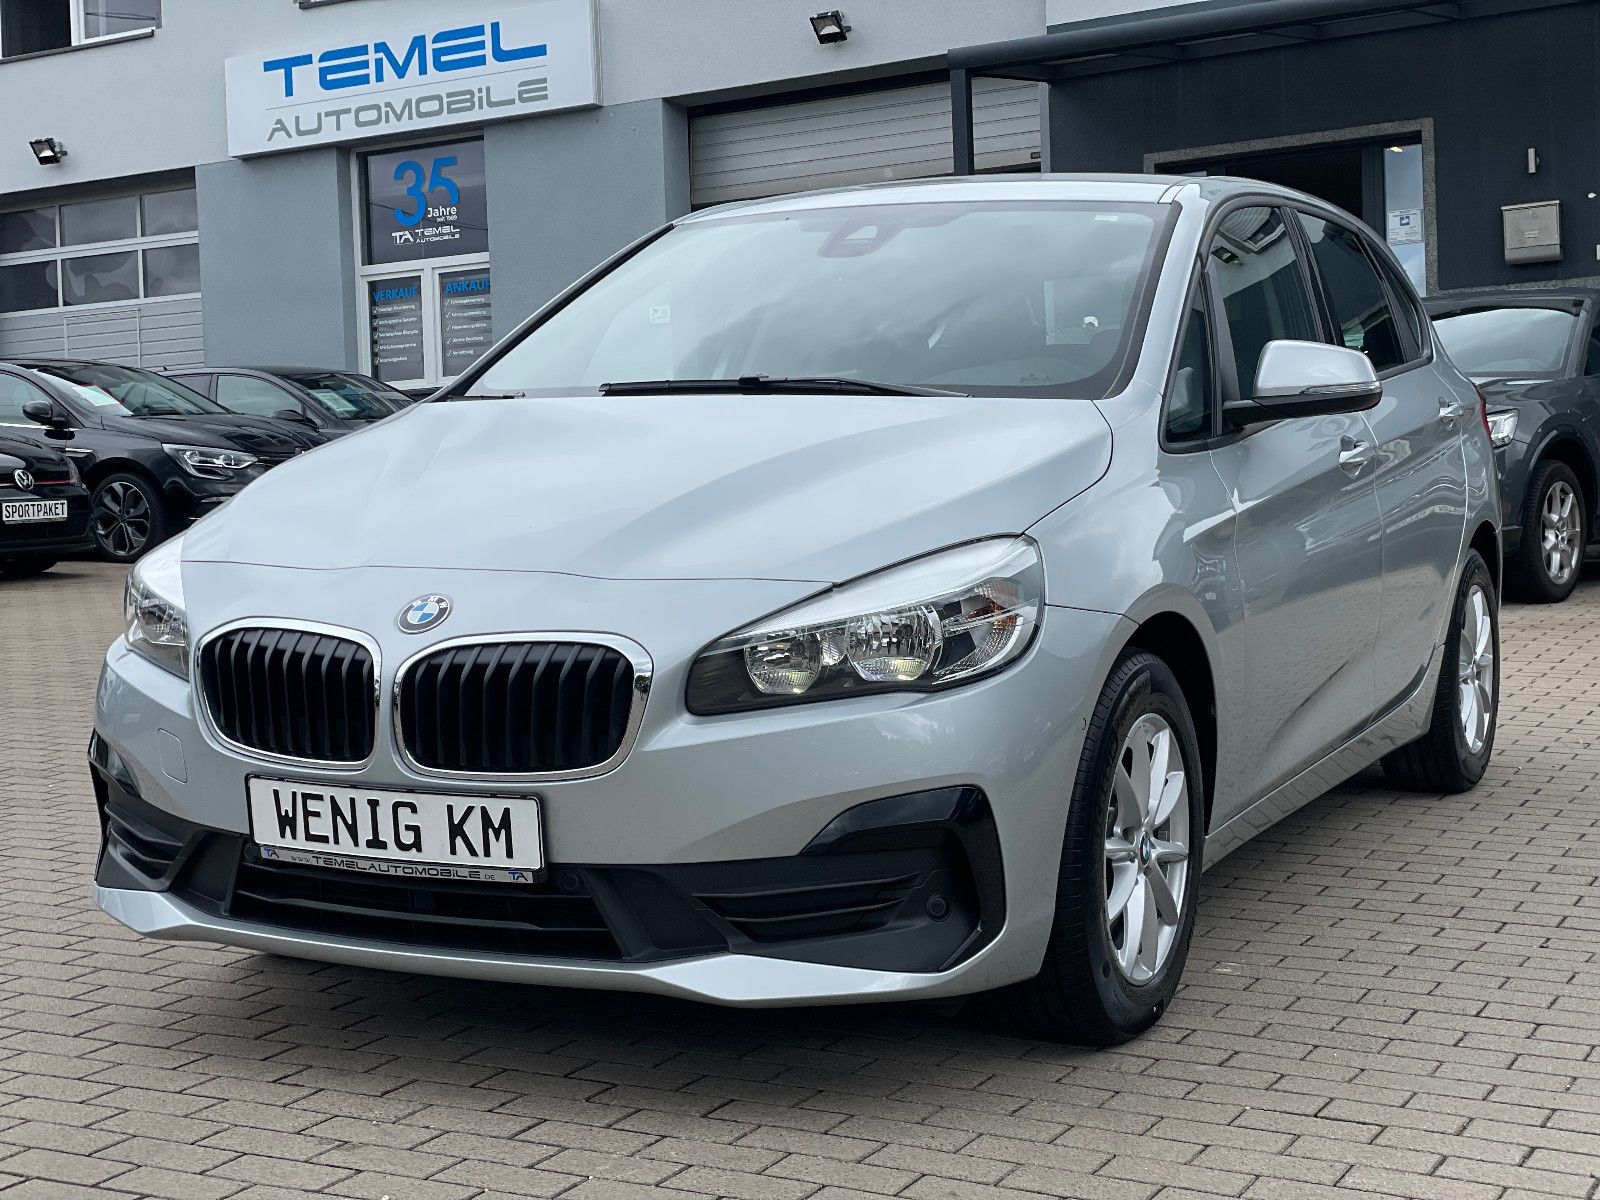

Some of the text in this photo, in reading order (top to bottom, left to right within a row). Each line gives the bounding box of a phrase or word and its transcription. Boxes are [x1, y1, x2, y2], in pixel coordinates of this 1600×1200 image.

[263, 21, 548, 98] TEMEL
[393, 155, 460, 227] 35
[427, 206, 457, 218] Jahre
[391, 230, 414, 245] TA
[415, 225, 460, 237] TEMEL
[373, 287, 418, 301] VERKAUF
[4, 502, 66, 519] SPORTPAKET
[272, 788, 514, 859] WENIG KM
[263, 848, 279, 858] TA
[507, 871, 529, 881] TA
